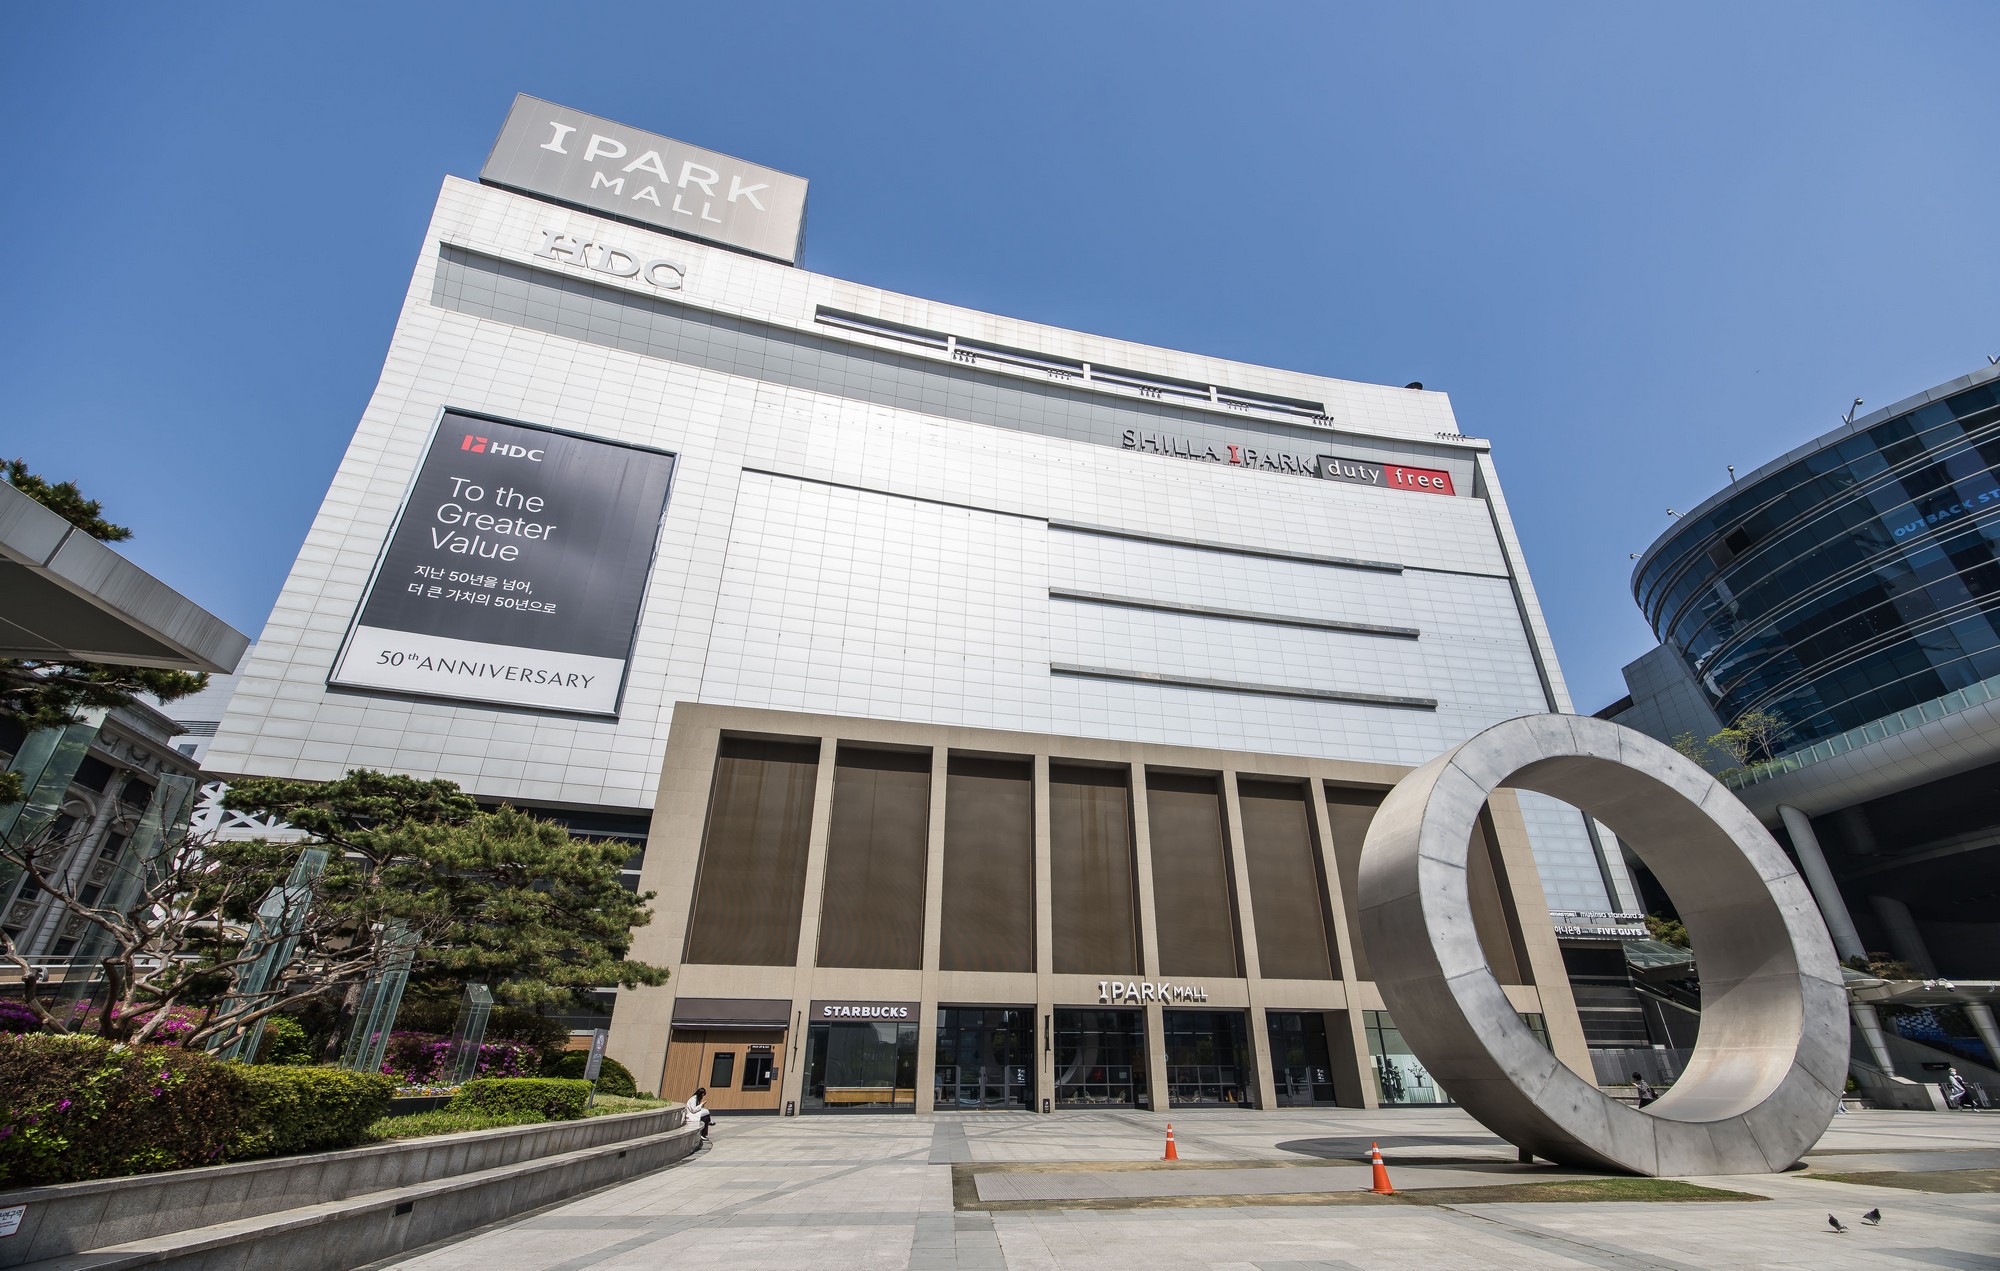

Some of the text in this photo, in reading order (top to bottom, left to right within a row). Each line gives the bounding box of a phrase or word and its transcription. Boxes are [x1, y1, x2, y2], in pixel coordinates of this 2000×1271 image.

[590, 170, 722, 225] MALL
[533, 230, 687, 291] HDC
[489, 441, 545, 462] HDC
[1122, 429, 1221, 463] SHILLA
[1327, 460, 1380, 485] duty
[1394, 468, 1445, 490] free
[449, 476, 545, 513] To the
[436, 502, 557, 541] Greater
[1894, 499, 1975, 537] OUTBACK
[431, 526, 519, 562] Value
[414, 564, 534, 596] 지난 50년을 넘어,
[407, 582, 557, 615] 더 큰 가치의 50년으로
[1597, 927, 1617, 935] FIVE
[1618, 928, 1642, 936] GUYS
[1173, 985, 1209, 997] MALL
[823, 1004, 909, 1019] STARBUCKS
